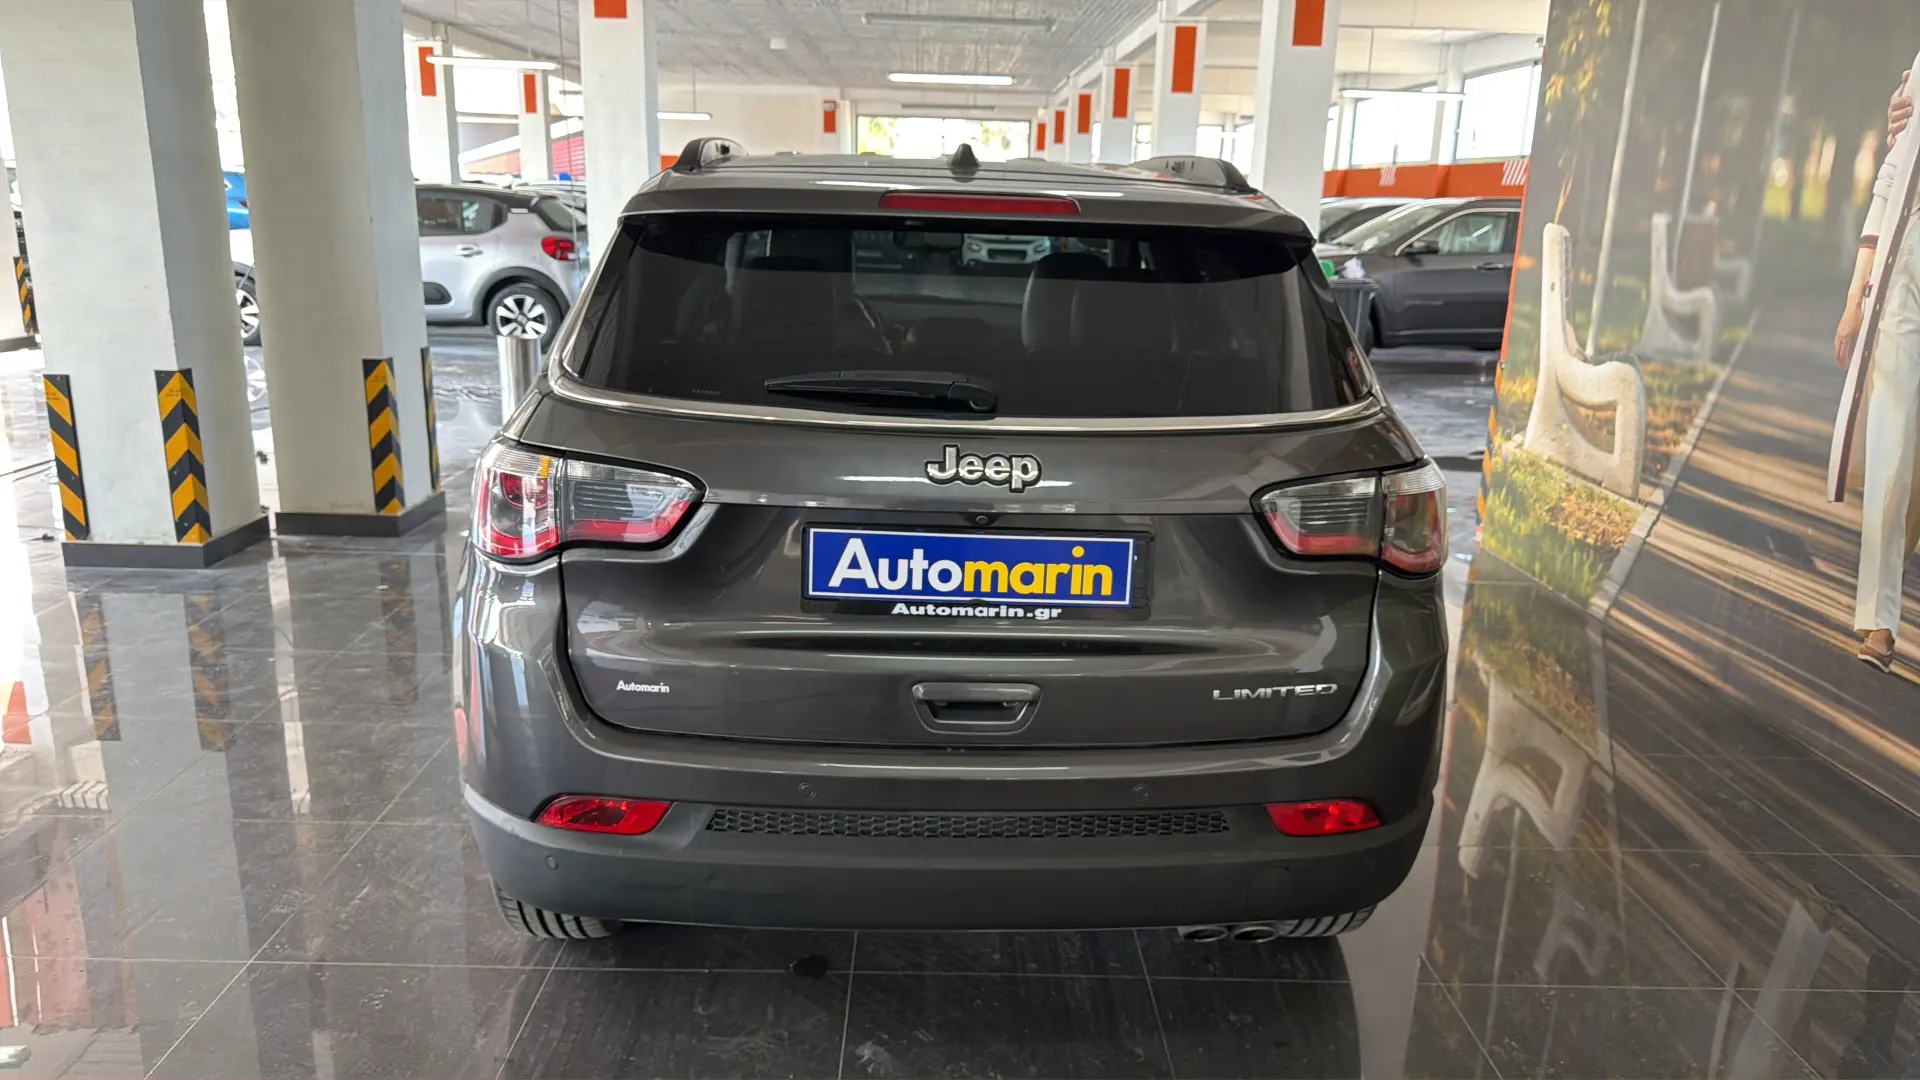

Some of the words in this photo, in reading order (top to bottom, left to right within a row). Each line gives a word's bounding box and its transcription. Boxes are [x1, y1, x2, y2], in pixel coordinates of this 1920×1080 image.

[926, 445, 1040, 491] Jeep
[828, 537, 1113, 595] Automarin
[891, 602, 1062, 620] Automarin.gr
[616, 679, 670, 693] Automarin
[1212, 683, 1338, 700] LIMITED
